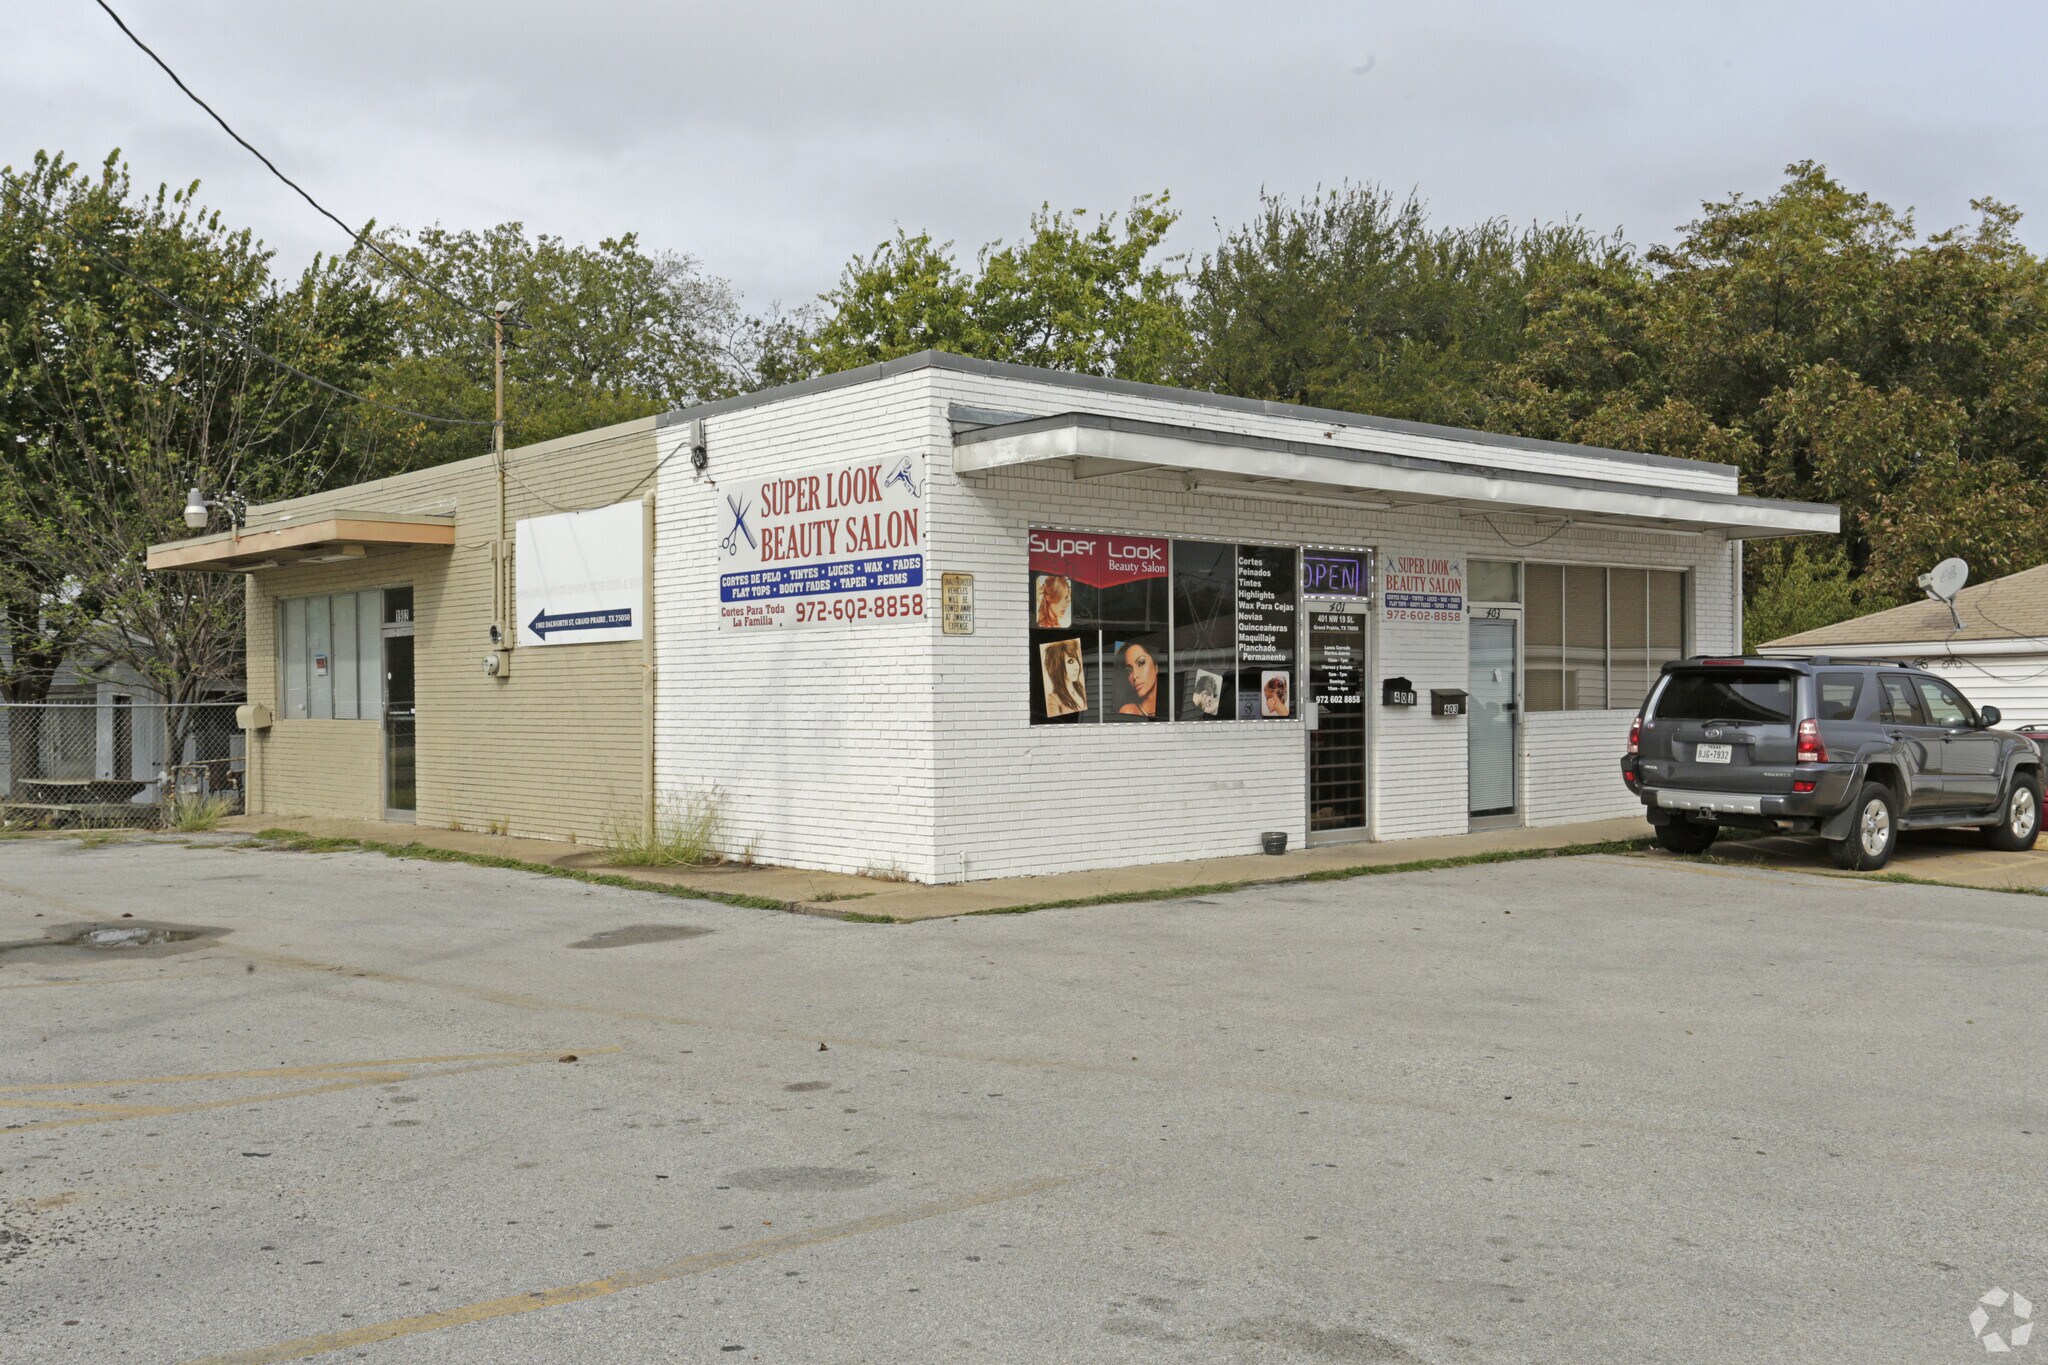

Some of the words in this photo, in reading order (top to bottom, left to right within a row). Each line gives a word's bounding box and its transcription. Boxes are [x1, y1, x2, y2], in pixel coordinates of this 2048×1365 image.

[761, 475, 820, 517] SUPER
[826, 465, 882, 508] LOOK
[761, 519, 839, 562] BEAUTY
[846, 508, 918, 553] SALON
[1030, 534, 1096, 557] Super
[1108, 541, 1162, 560] Look
[1238, 556, 1263, 566] Cortes
[1398, 557, 1425, 574] SUPER
[1427, 559, 1450, 575] LOOK
[722, 575, 749, 587] CORTES
[751, 573, 760, 584] DE
[762, 571, 781, 583] PELO
[790, 568, 818, 580] TINTES
[828, 564, 854, 576] LUCES
[864, 561, 883, 573] WAX
[893, 557, 921, 570] FADES
[1108, 560, 1139, 574] Beauty
[1142, 561, 1166, 573] Salon
[1238, 567, 1271, 577] Peinados
[1303, 563, 1355, 590] OPEN
[732, 588, 750, 598] FLAT
[752, 585, 770, 596] TOPS
[779, 582, 804, 594] BOOTY
[806, 579, 830, 592] FADES
[840, 576, 867, 588] TAPER
[877, 573, 908, 586] PERMS
[1238, 578, 1261, 588] Tintes
[1386, 575, 1426, 592] BEAUTY
[1429, 577, 1461, 593] SALON
[948, 587, 968, 595] VEHICLES
[1238, 589, 1275, 601] Highlights
[721, 607, 744, 617] Cortes
[746, 605, 763, 615] Para
[765, 603, 785, 614] Toda
[796, 593, 923, 622] 972-602-8858
[1238, 601, 1254, 609] Wax
[1256, 601, 1272, 610] Para
[1274, 602, 1294, 612] Cejas
[575, 617, 589, 625] GRAND
[616, 613, 630, 622] 75050
[1238, 612, 1263, 621] Novias
[1318, 615, 1328, 623] 401
[1329, 615, 1338, 623] NW
[1486, 608, 1500, 619] 403
[733, 617, 742, 627] La
[744, 615, 773, 627] Familia
[948, 622, 968, 630] EXPENSE
[1238, 622, 1288, 632] Quinceañeras
[1238, 633, 1276, 643] Maquillaje
[1238, 643, 1276, 652] Planchado
[1243, 652, 1286, 661] Permanente
[1316, 695, 1328, 703] 972
[1330, 695, 1343, 703] 602
[1394, 692, 1413, 704] 401
[1444, 704, 1458, 715] 403
